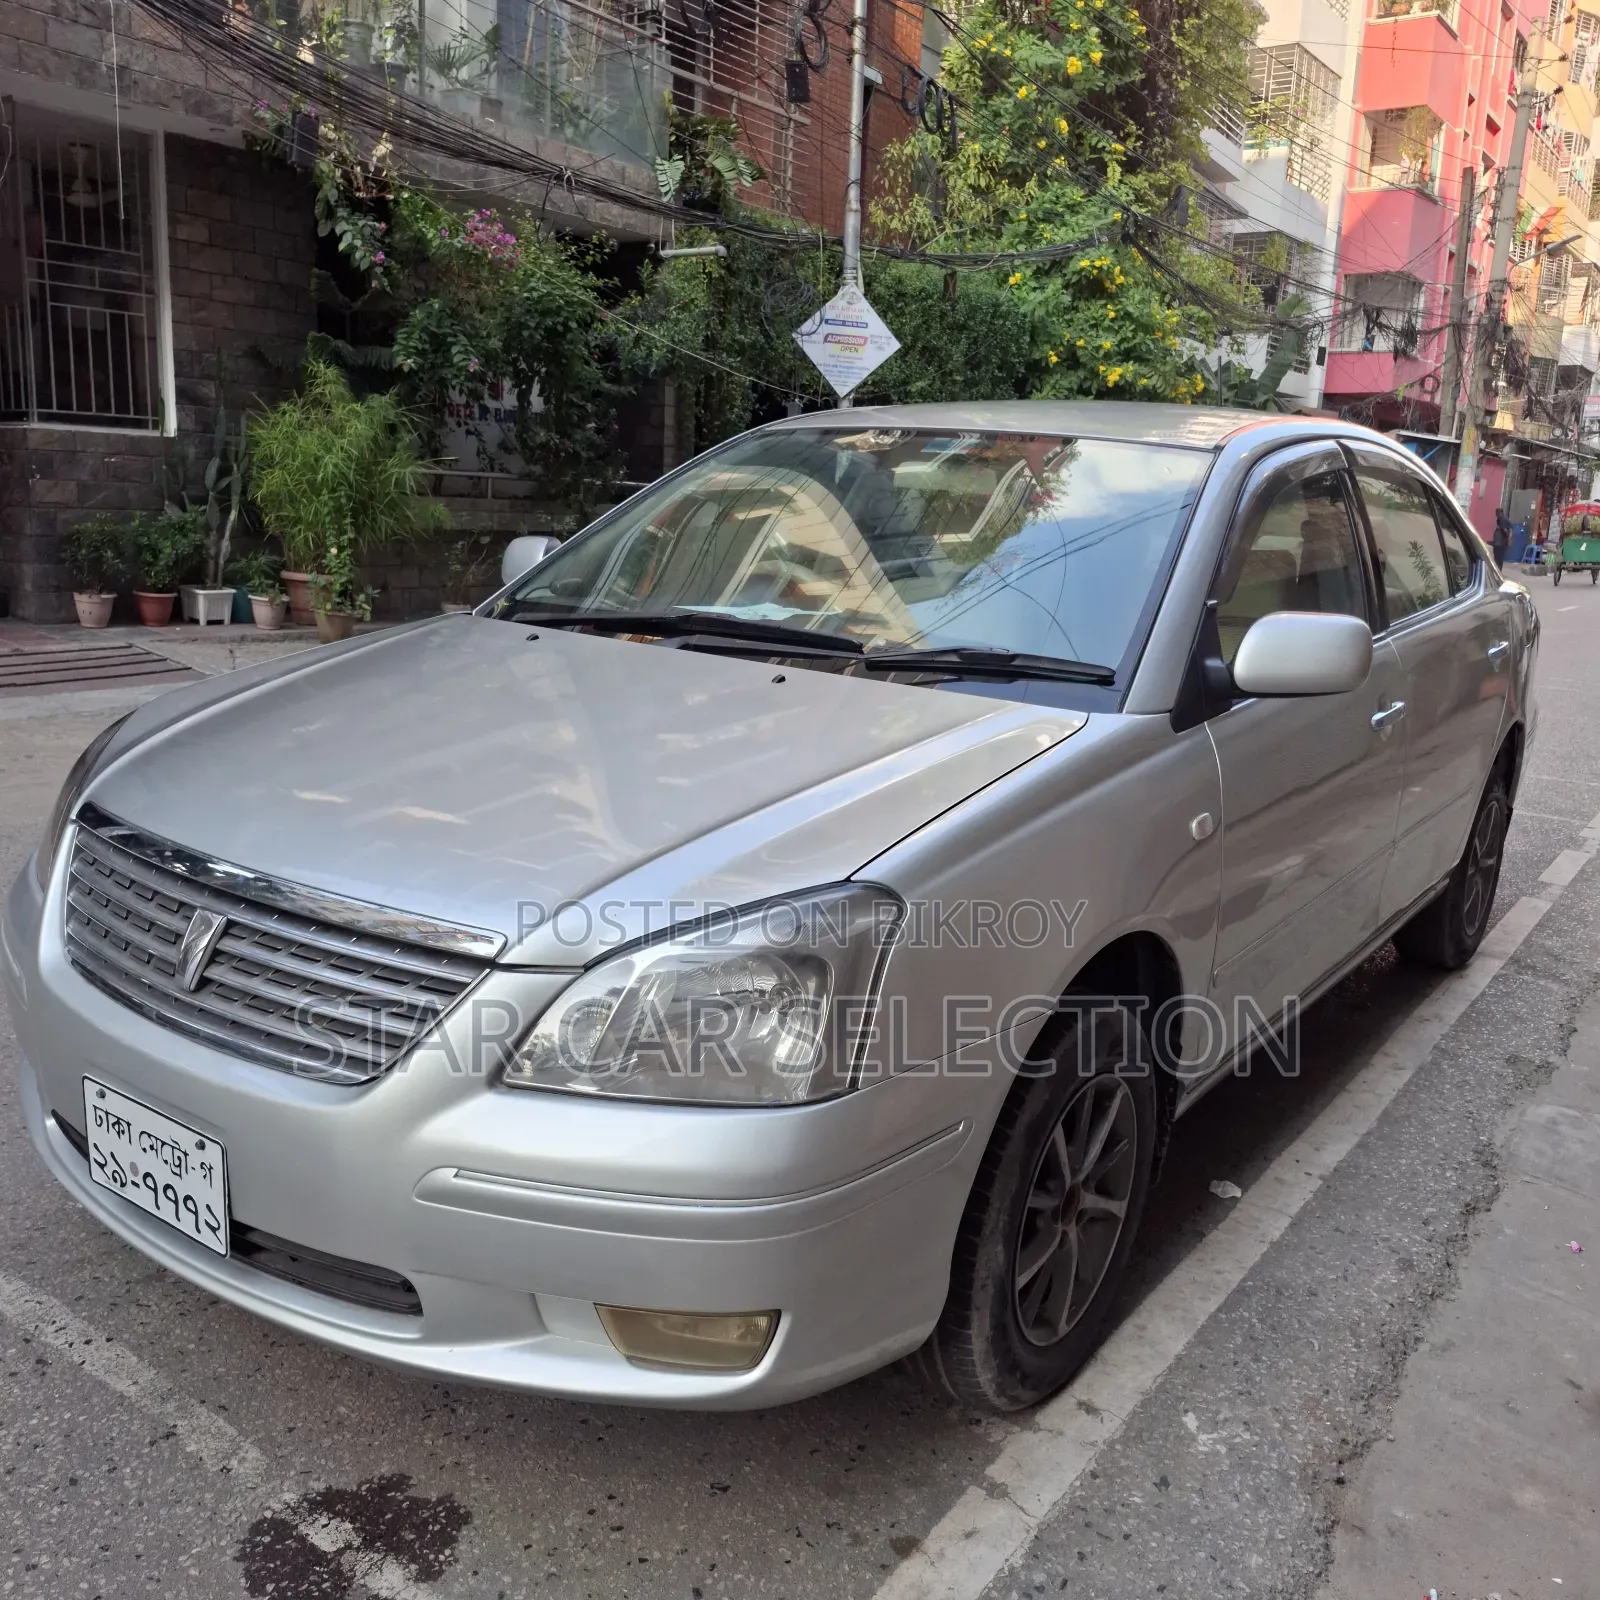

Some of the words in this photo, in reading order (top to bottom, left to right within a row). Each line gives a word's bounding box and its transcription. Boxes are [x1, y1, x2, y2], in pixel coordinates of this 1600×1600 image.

[827, 334, 865, 345] ADMISSION
[840, 345, 859, 354] OPEN
[92, 1103, 133, 1146] ঢাকা
[92, 1142, 224, 1247] ২৯-৭৭৭২
